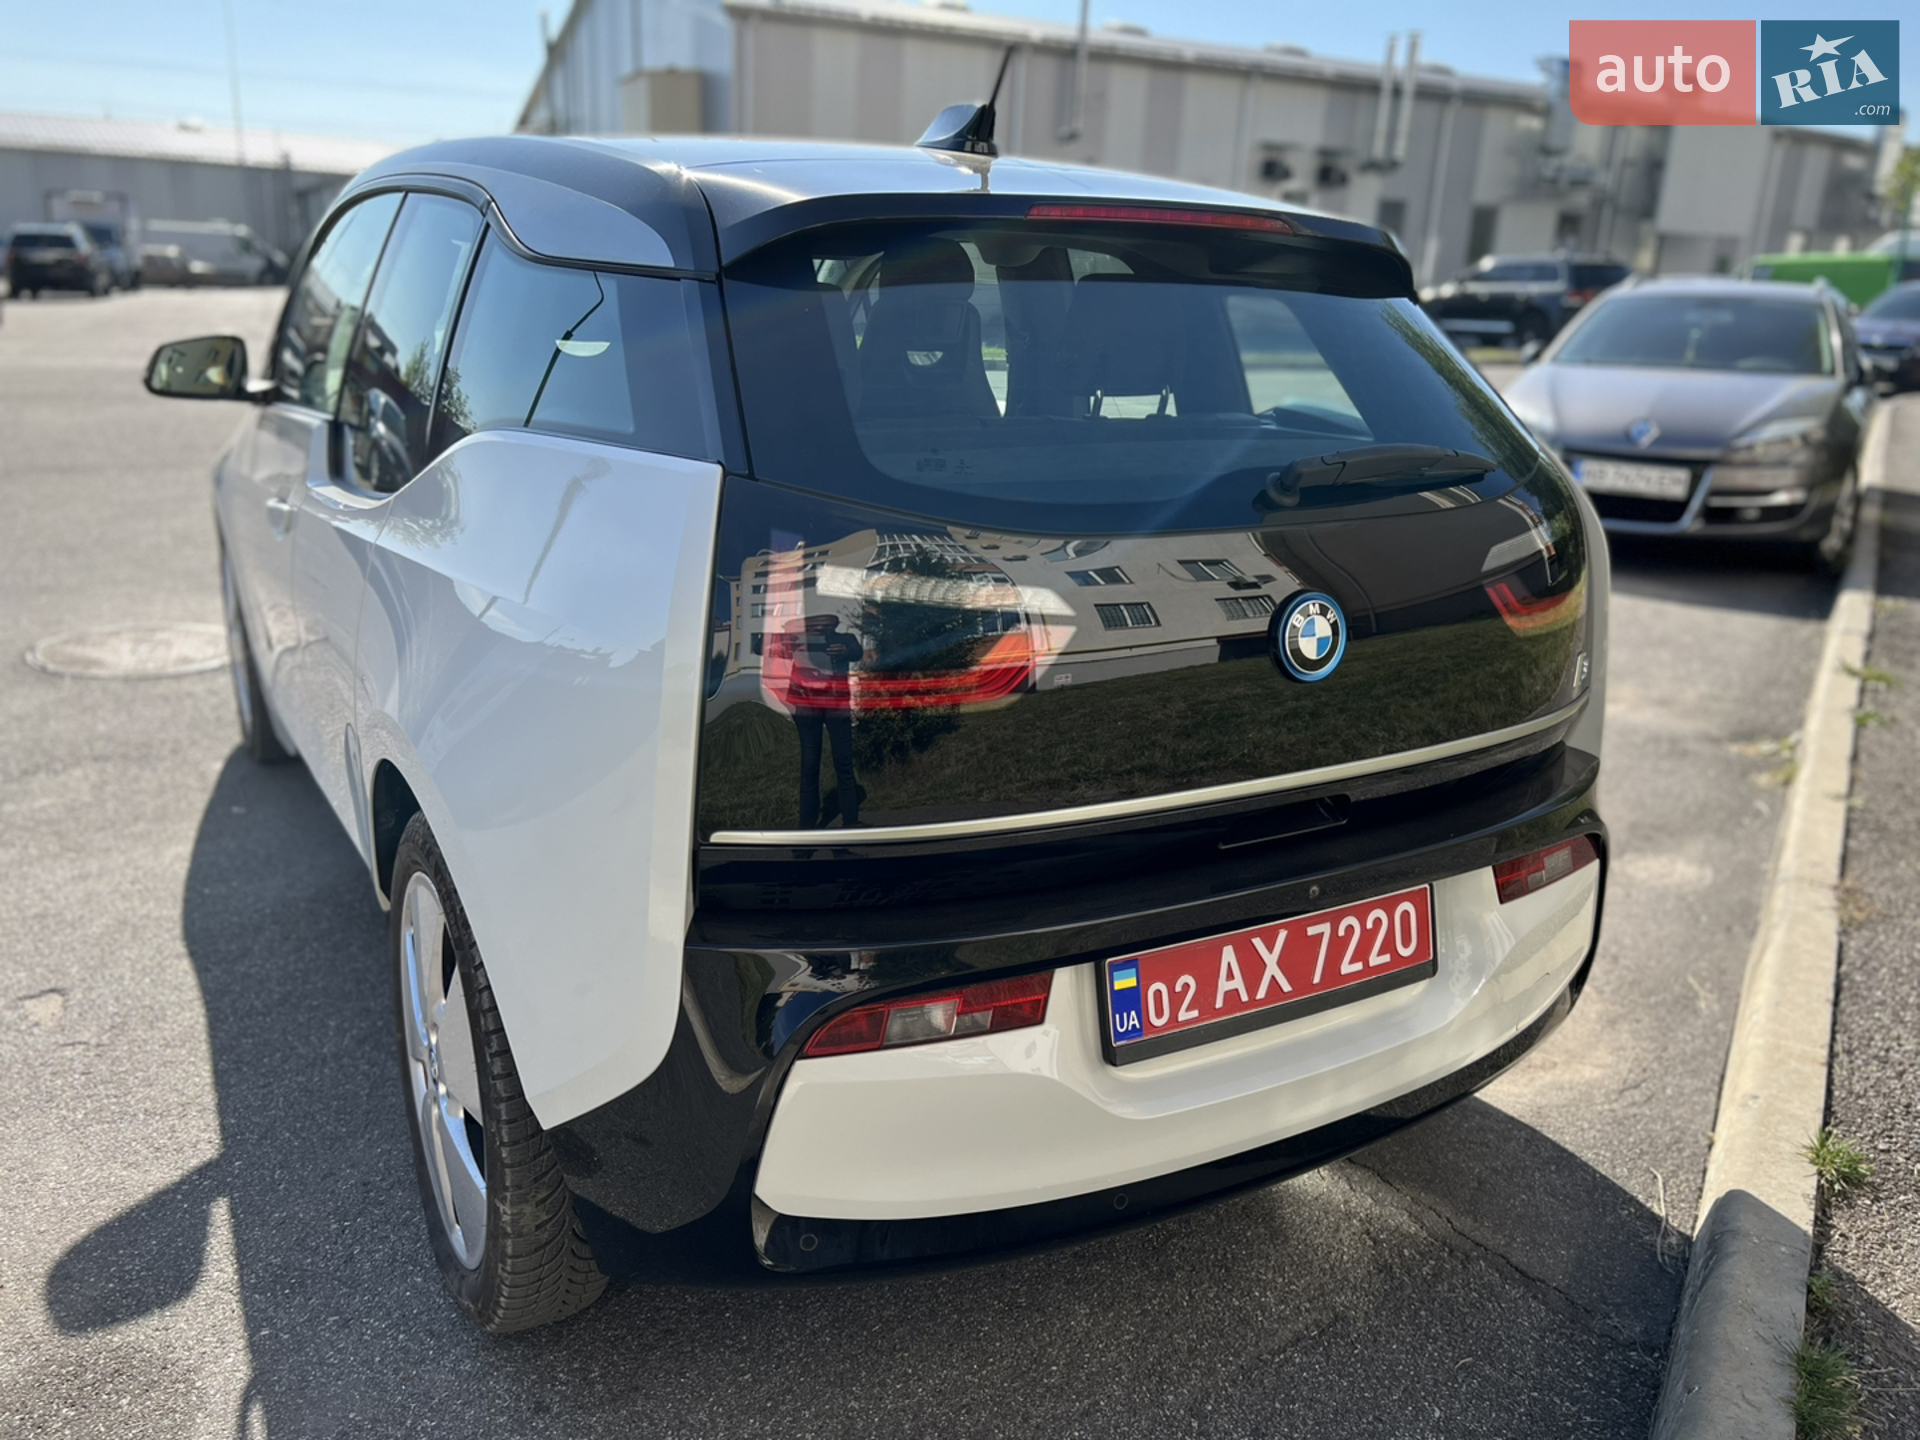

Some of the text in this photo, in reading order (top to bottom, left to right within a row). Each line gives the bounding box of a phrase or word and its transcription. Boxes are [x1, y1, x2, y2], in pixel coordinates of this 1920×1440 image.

[1292, 602, 1337, 628] BMW
[1147, 901, 1418, 1028] 02 AX 7220
[1115, 1009, 1141, 1033] UA
